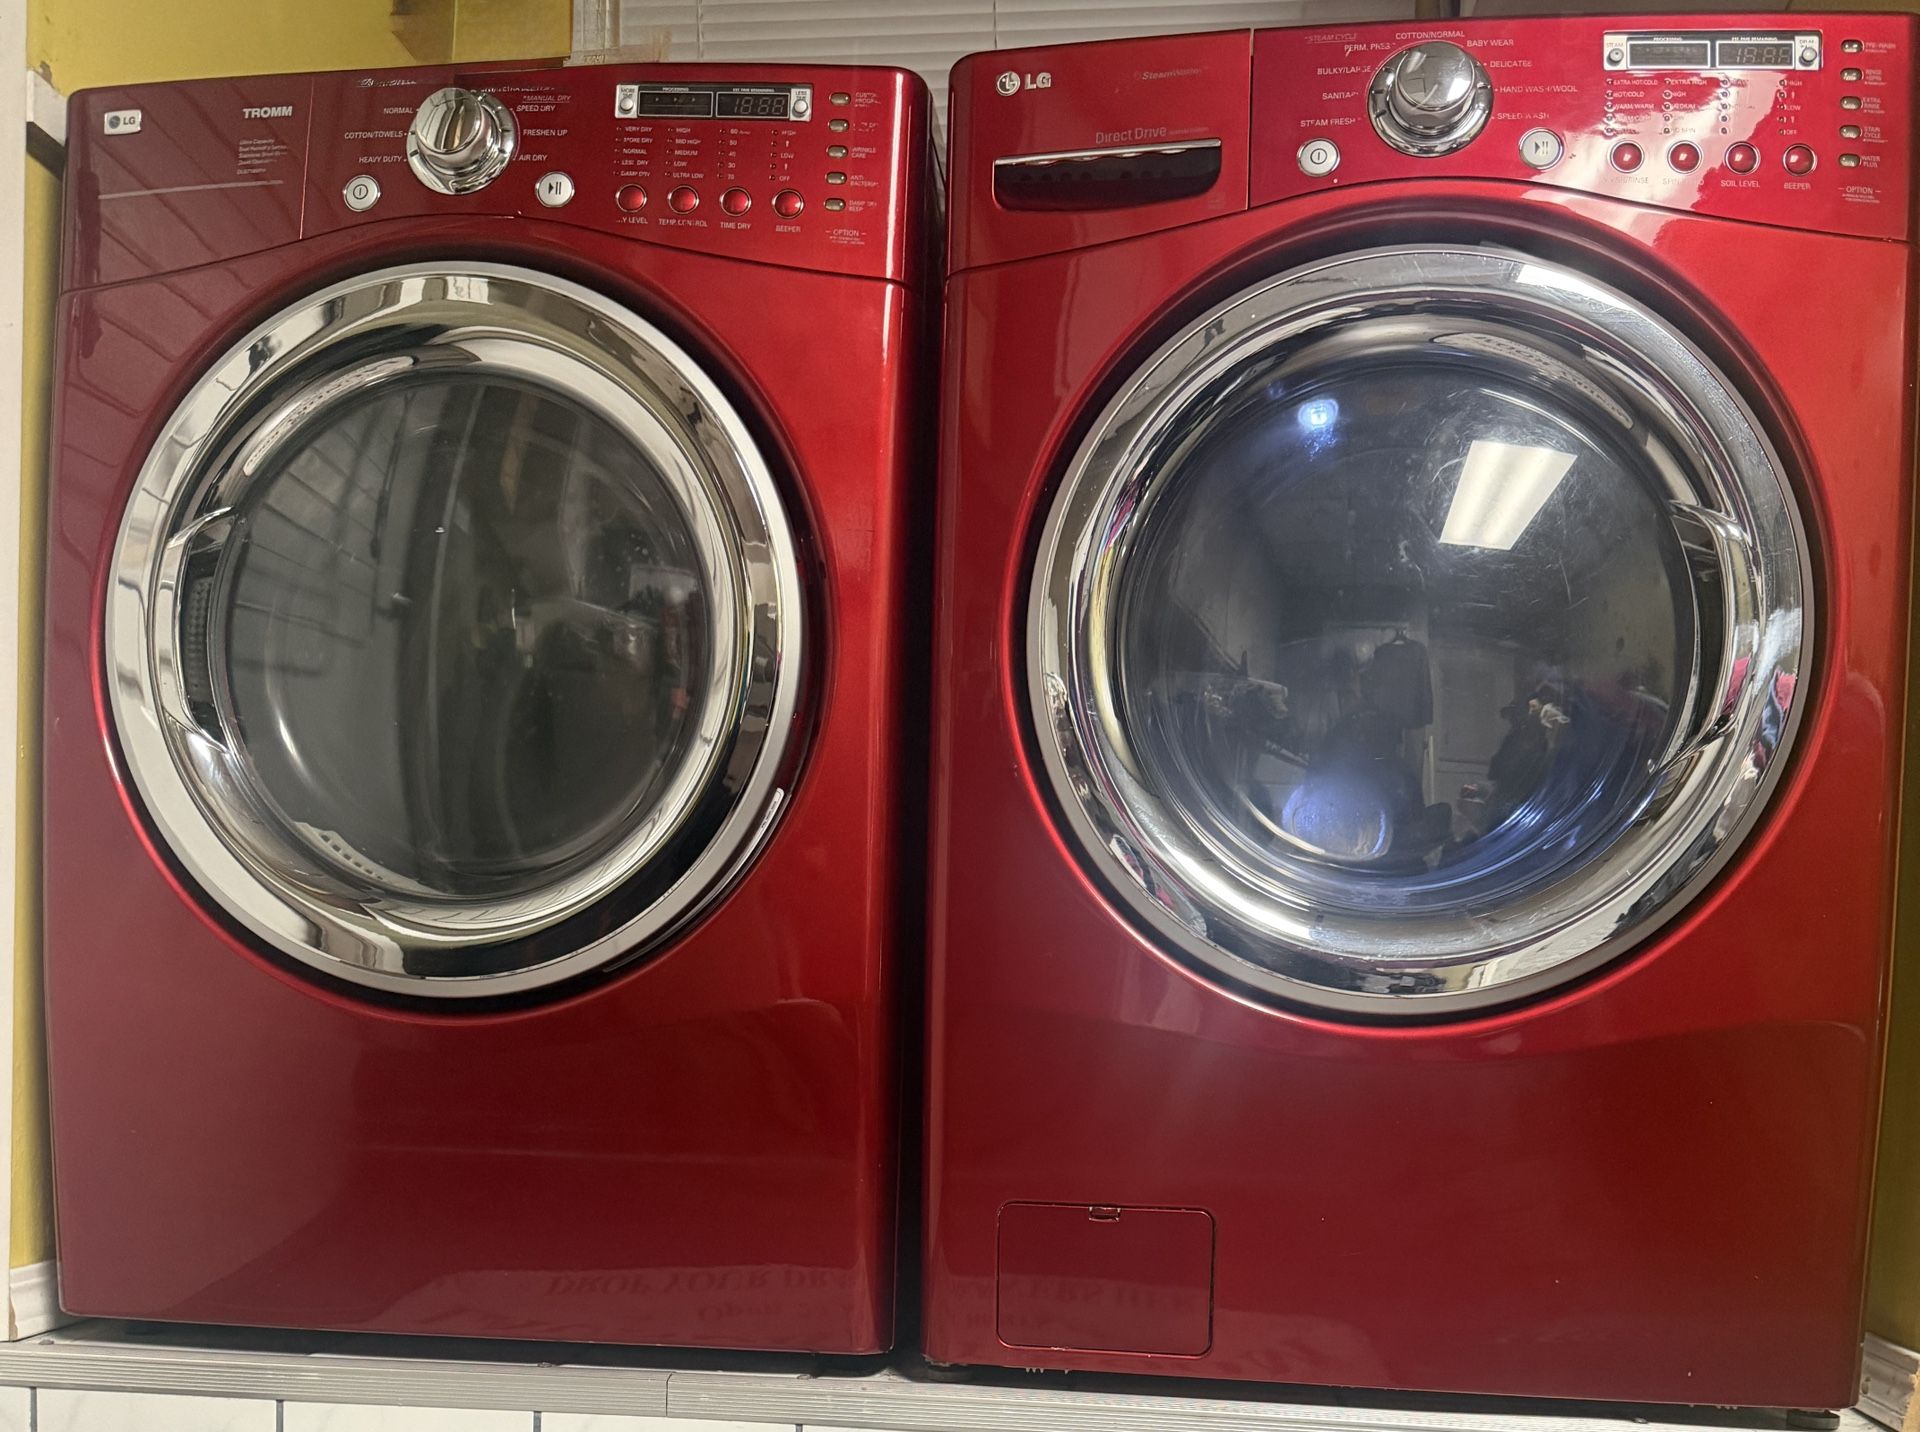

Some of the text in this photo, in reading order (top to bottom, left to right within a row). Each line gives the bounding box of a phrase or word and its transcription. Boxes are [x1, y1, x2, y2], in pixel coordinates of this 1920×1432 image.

[1395, 30, 1465, 40] COTTON/NORMAL
[1344, 43, 1368, 51] PERM.
[1466, 39, 1514, 47] BABY WEAR
[1024, 72, 1051, 90] LG
[242, 105, 293, 119] TROMM
[383, 107, 413, 115] NORMAL
[516, 104, 555, 112] SPEED DRY
[1497, 112, 1522, 120] SPEED
[123, 116, 136, 126] LG
[1300, 117, 1356, 127] STEAM FRESH
[344, 130, 403, 140] COTTON/TOWELS
[1095, 129, 1133, 144] Direct
[1134, 127, 1167, 140] Drive
[358, 155, 402, 164] HEAVY DUTY
[1720, 179, 1760, 188] SOIL LEVEL
[1783, 182, 1811, 190] BEEPER
[1846, 186, 1873, 194] OPTION
[628, 217, 648, 225] LEVEL
[720, 221, 751, 230] TIME DRY
[775, 225, 801, 233] BEEPER
[833, 228, 859, 236] OPTION
